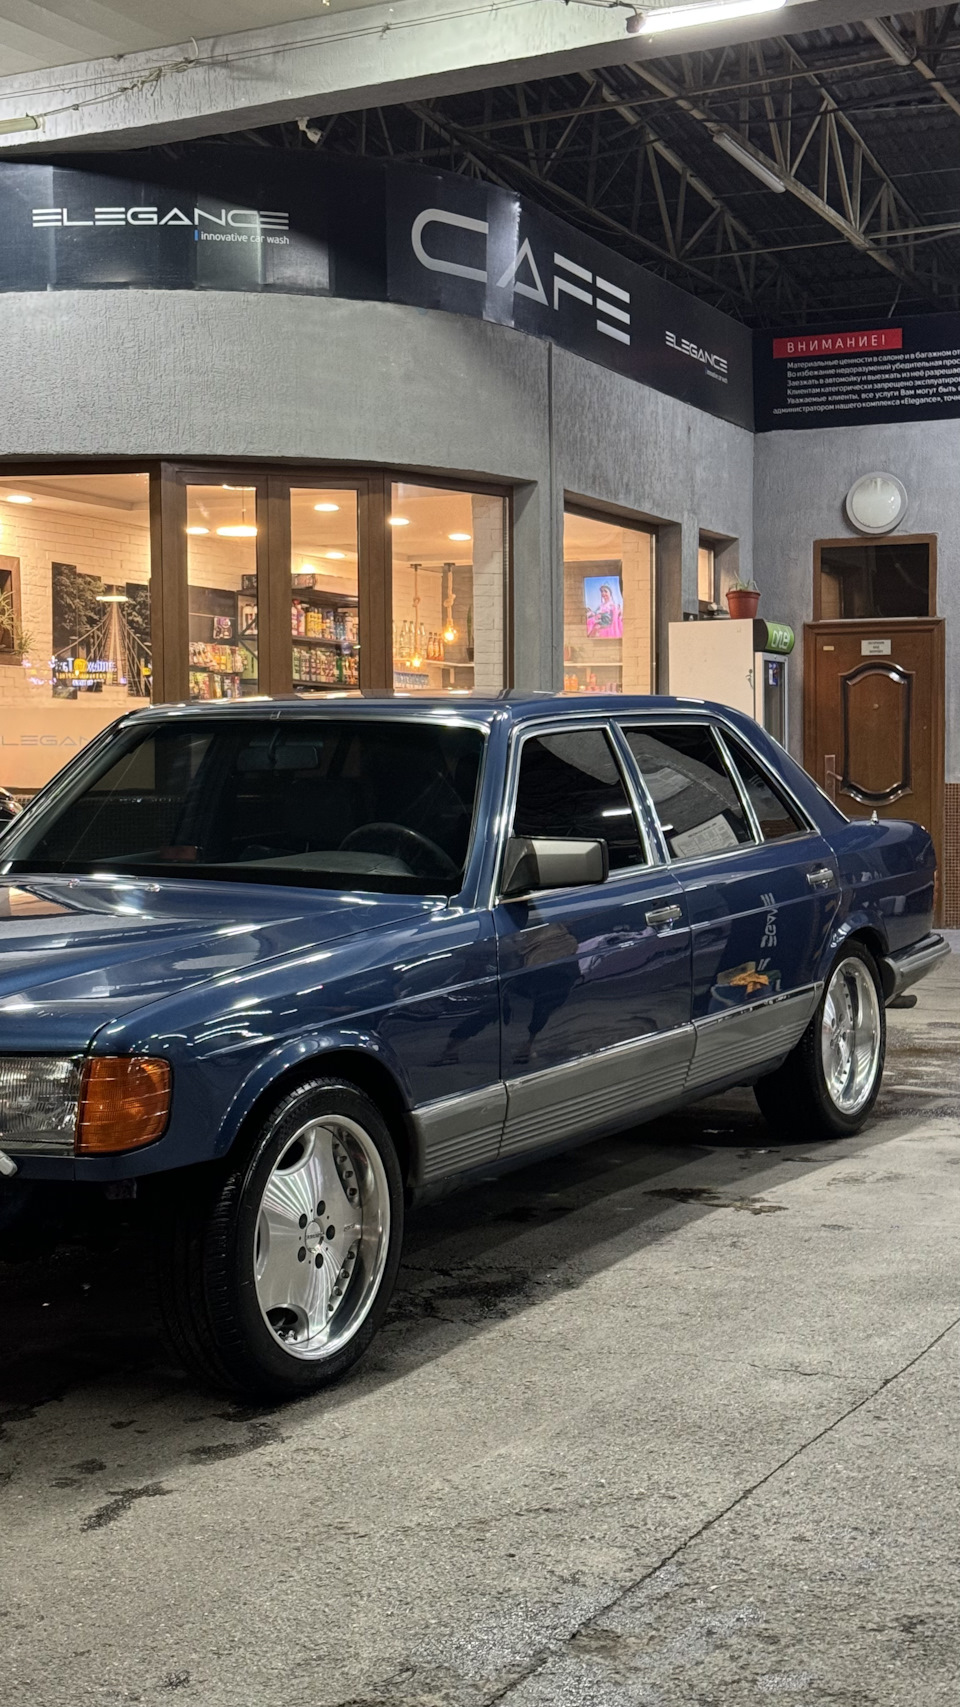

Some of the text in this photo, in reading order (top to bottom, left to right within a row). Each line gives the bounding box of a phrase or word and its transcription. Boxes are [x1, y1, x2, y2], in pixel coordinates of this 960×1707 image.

[32, 206, 289, 230] ELEGANCE
[200, 231, 290, 245] innovative car wash
[411, 208, 630, 346] CAFE
[665, 331, 728, 374] ELEGANCE
[786, 334, 886, 353] ВНИМАНИЕ!
[786, 359, 838, 369] Материальные
[839, 357, 873, 366] ценности
[915, 350, 951, 359] багажном
[796, 368, 836, 377] избежание
[836, 363, 891, 374] недоразумений
[891, 360, 942, 371] убедительная
[786, 378, 819, 387] Заезжать
[825, 375, 861, 384] автомойку
[867, 372, 901, 380] выезжать
[786, 387, 820, 396] Клиентам
[820, 383, 873, 393] категорически
[873, 380, 913, 389] запрещено
[786, 396, 827, 404] Уважаемые
[875, 390, 899, 399] услуги
[900, 388, 914, 396] Вам
[916, 387, 936, 395] могут
[938, 385, 956, 393] быть
[772, 403, 835, 414] администратором
[862, 399, 900, 408] комплекса
